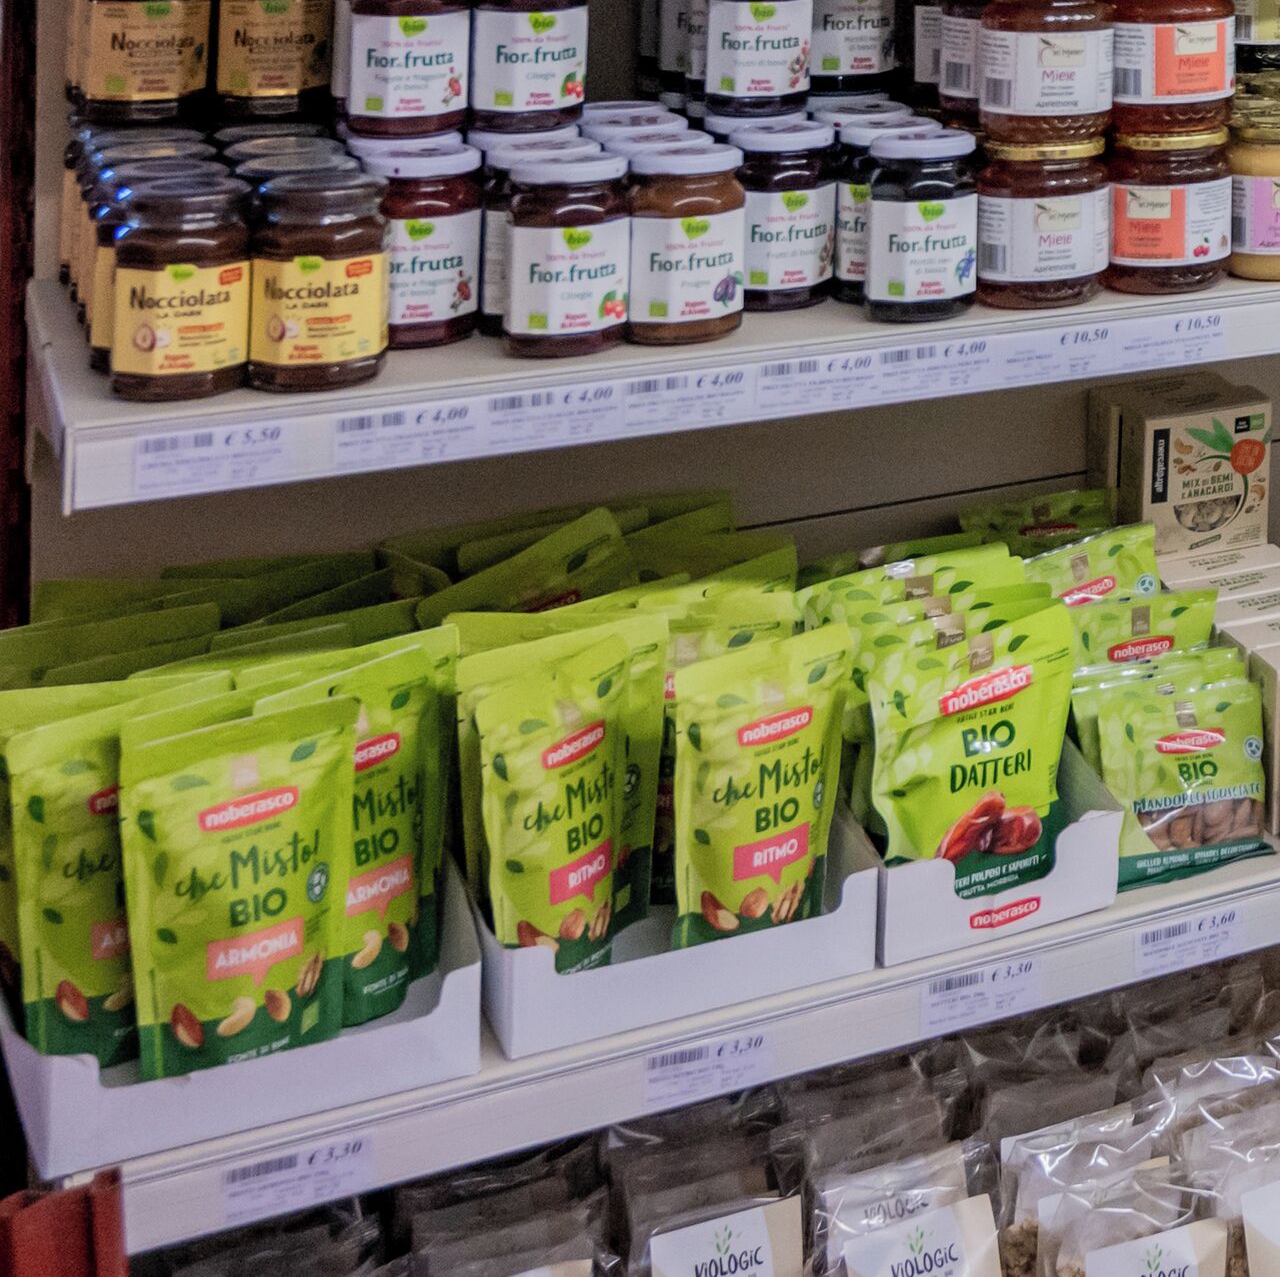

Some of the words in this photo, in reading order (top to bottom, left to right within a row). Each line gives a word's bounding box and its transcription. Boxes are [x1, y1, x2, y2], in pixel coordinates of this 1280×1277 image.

[1042, 69, 1076, 82] Miele
[1039, 232, 1073, 246] Miele
[1182, 476, 1200, 491] MIX
[1211, 473, 1233, 485] SEMI
[1113, 638, 1171, 659] noberasco
[947, 666, 1030, 712] noberasco
[741, 711, 810, 743] noberasco
[962, 720, 1016, 758] BIO
[546, 725, 605, 768] noberasco
[949, 754, 1032, 793] DATTERI
[1178, 761, 1219, 781] BIO
[204, 790, 296, 829] noberasco
[754, 797, 800, 834] BIO
[354, 829, 400, 866] BIO
[566, 814, 604, 854] BIO
[752, 838, 799, 868] RITMO
[567, 856, 606, 889] RITMO
[229, 887, 288, 928] BIO
[973, 899, 1039, 927] noberasco
[1198, 917, 1207, 931] €
[1210, 912, 1236, 929] 3,60
[214, 931, 298, 971] ARMONIA
